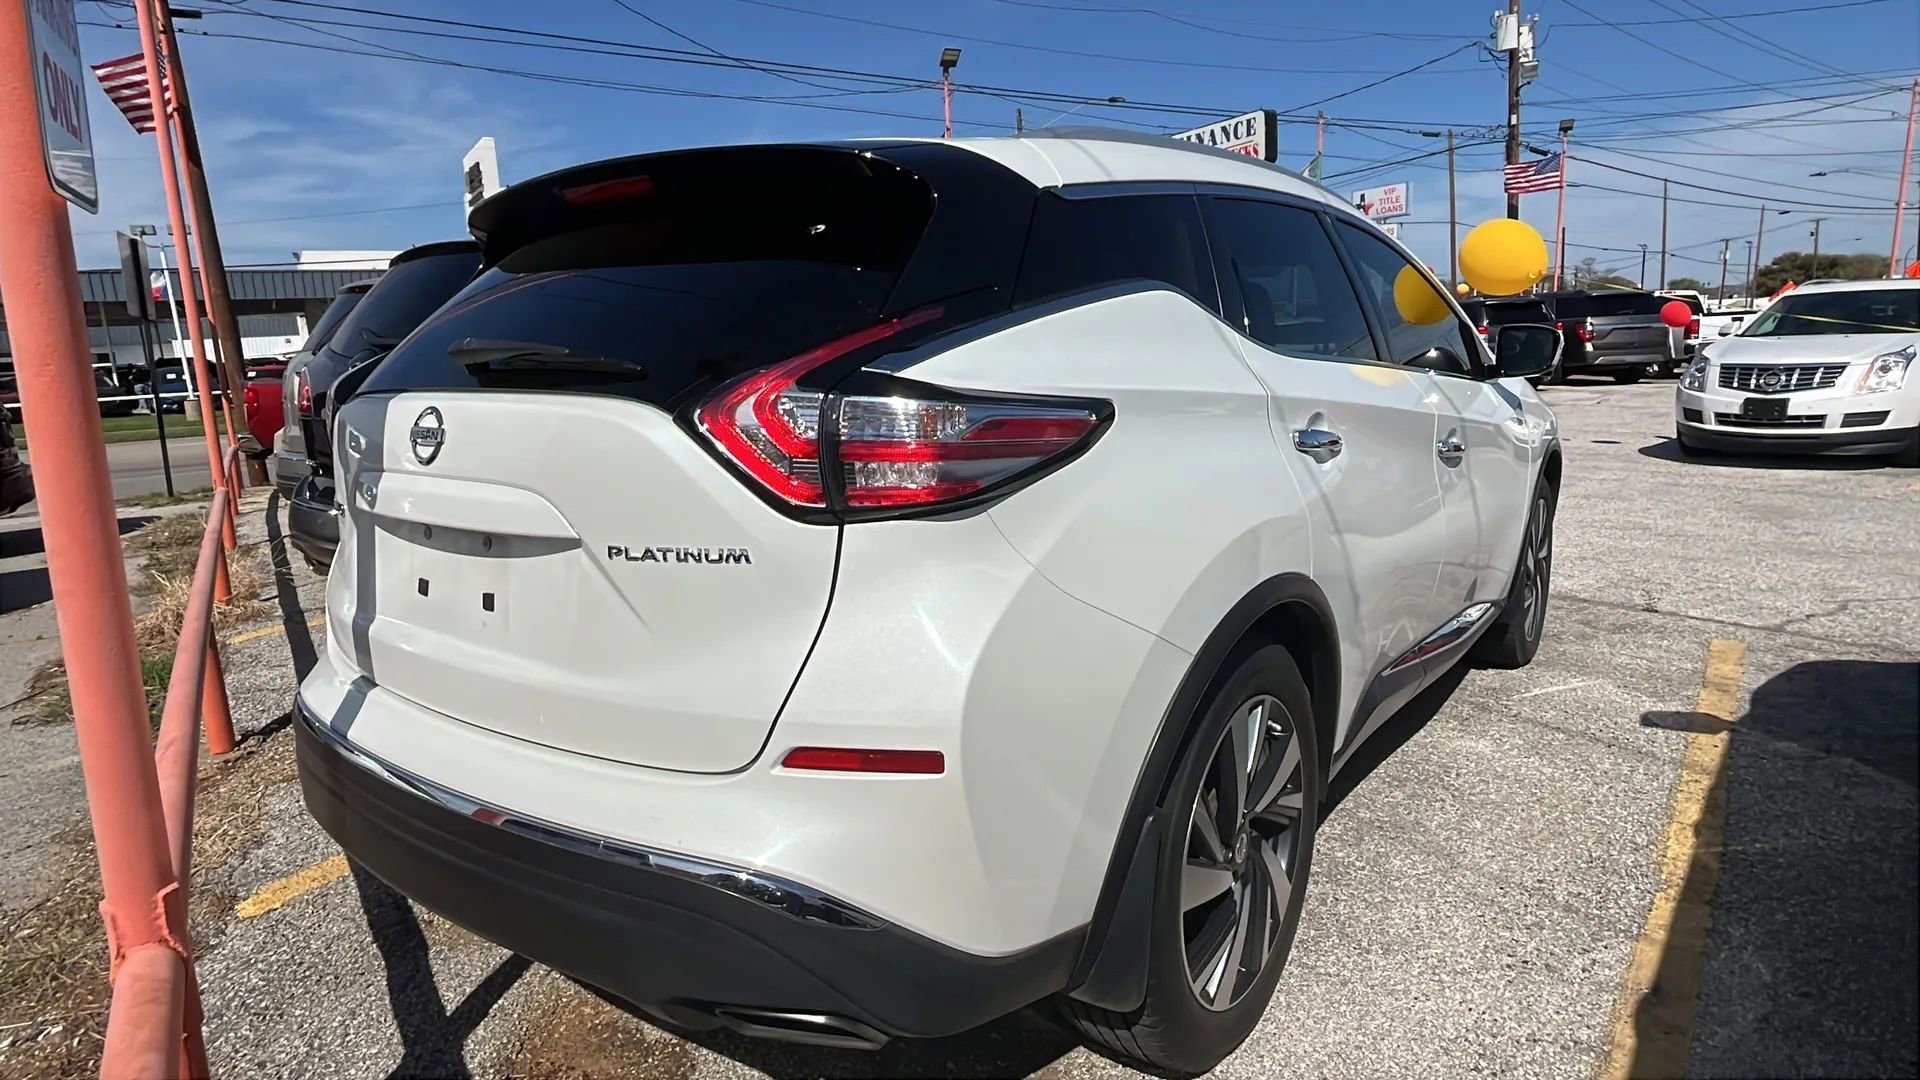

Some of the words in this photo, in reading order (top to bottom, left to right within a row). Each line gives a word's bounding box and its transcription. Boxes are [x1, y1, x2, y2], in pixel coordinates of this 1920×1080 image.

[43, 51, 83, 143] ONLY
[1180, 117, 1257, 147] NANCE
[1383, 187, 1397, 196] VIP
[1378, 195, 1401, 206] TITLE
[1375, 204, 1404, 215] LOANS
[607, 545, 752, 565] PLATINUM
